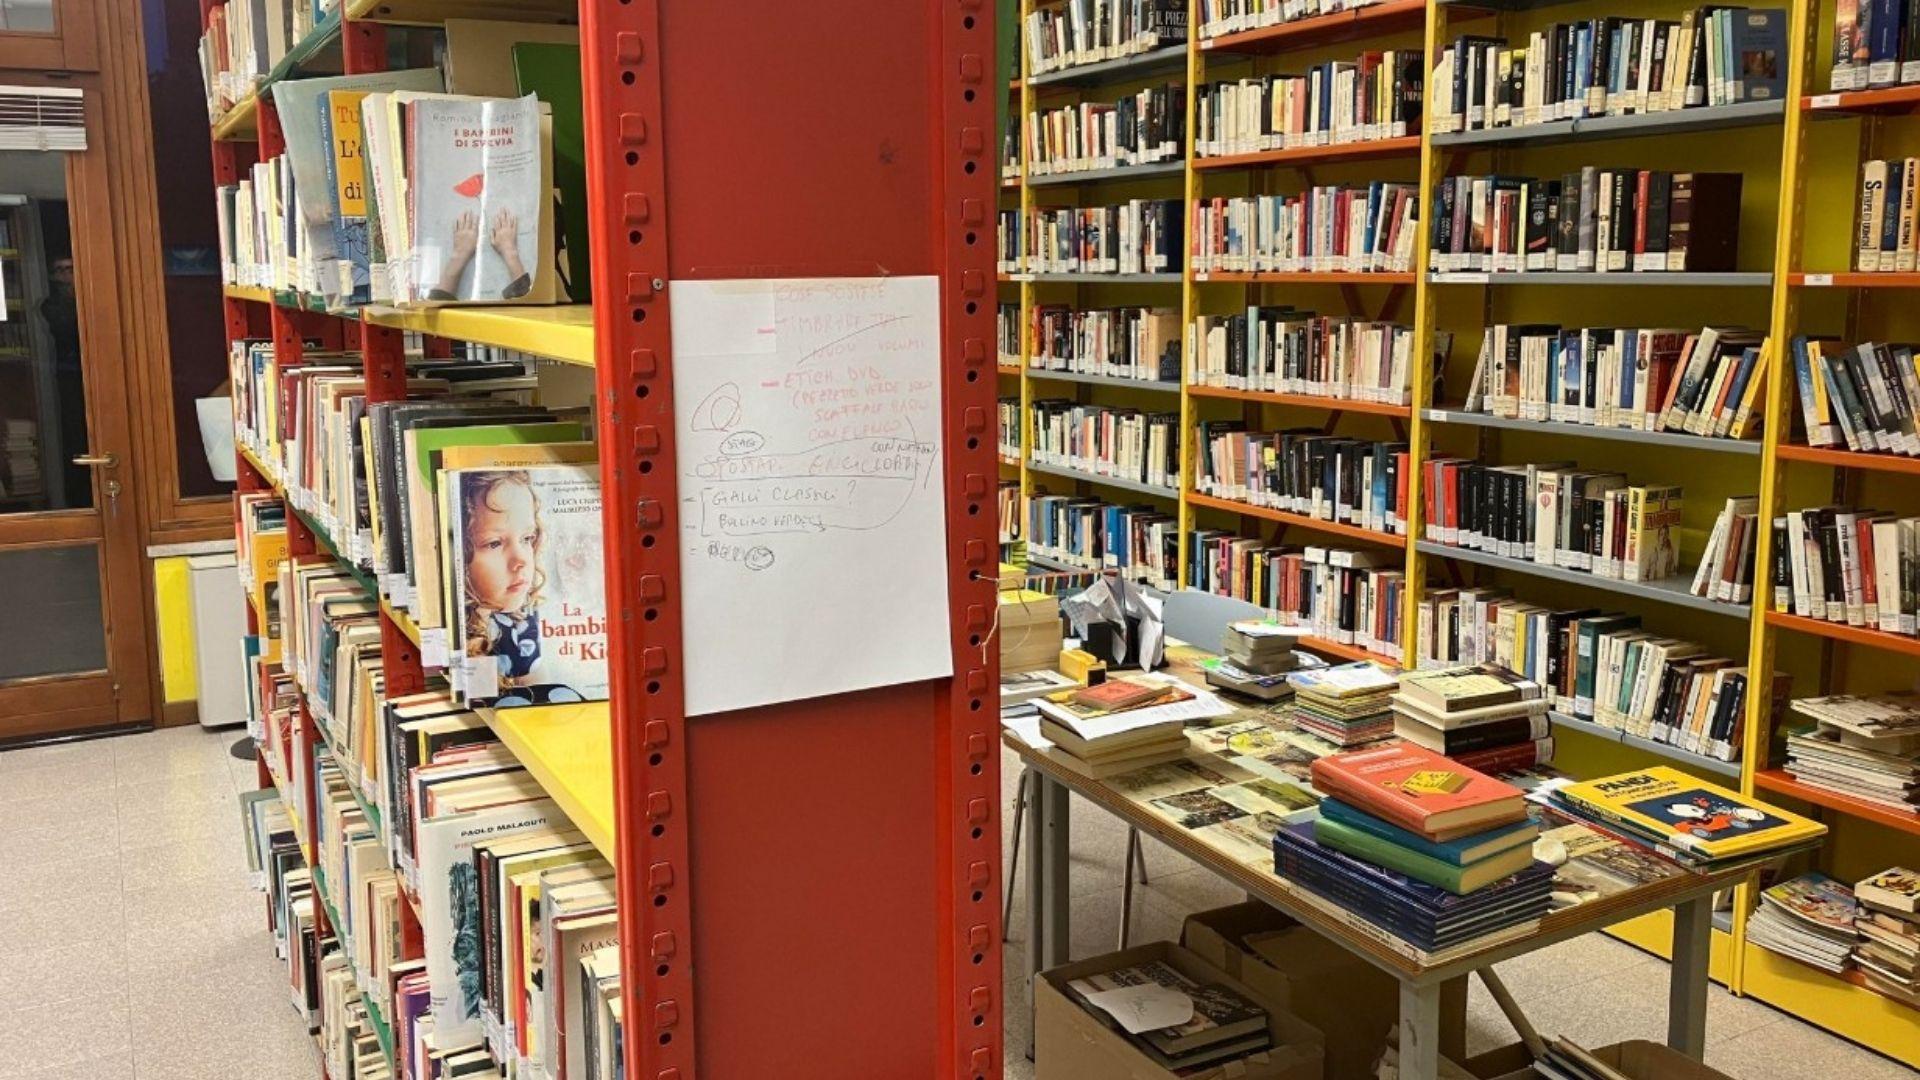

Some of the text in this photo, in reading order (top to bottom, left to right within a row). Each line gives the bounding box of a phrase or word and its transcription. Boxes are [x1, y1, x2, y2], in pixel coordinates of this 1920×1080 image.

[454, 139, 469, 148] DI
[344, 182, 362, 200] di
[563, 602, 582, 617] La
[559, 640, 575, 656] di
[461, 827, 494, 837] PAOLO
